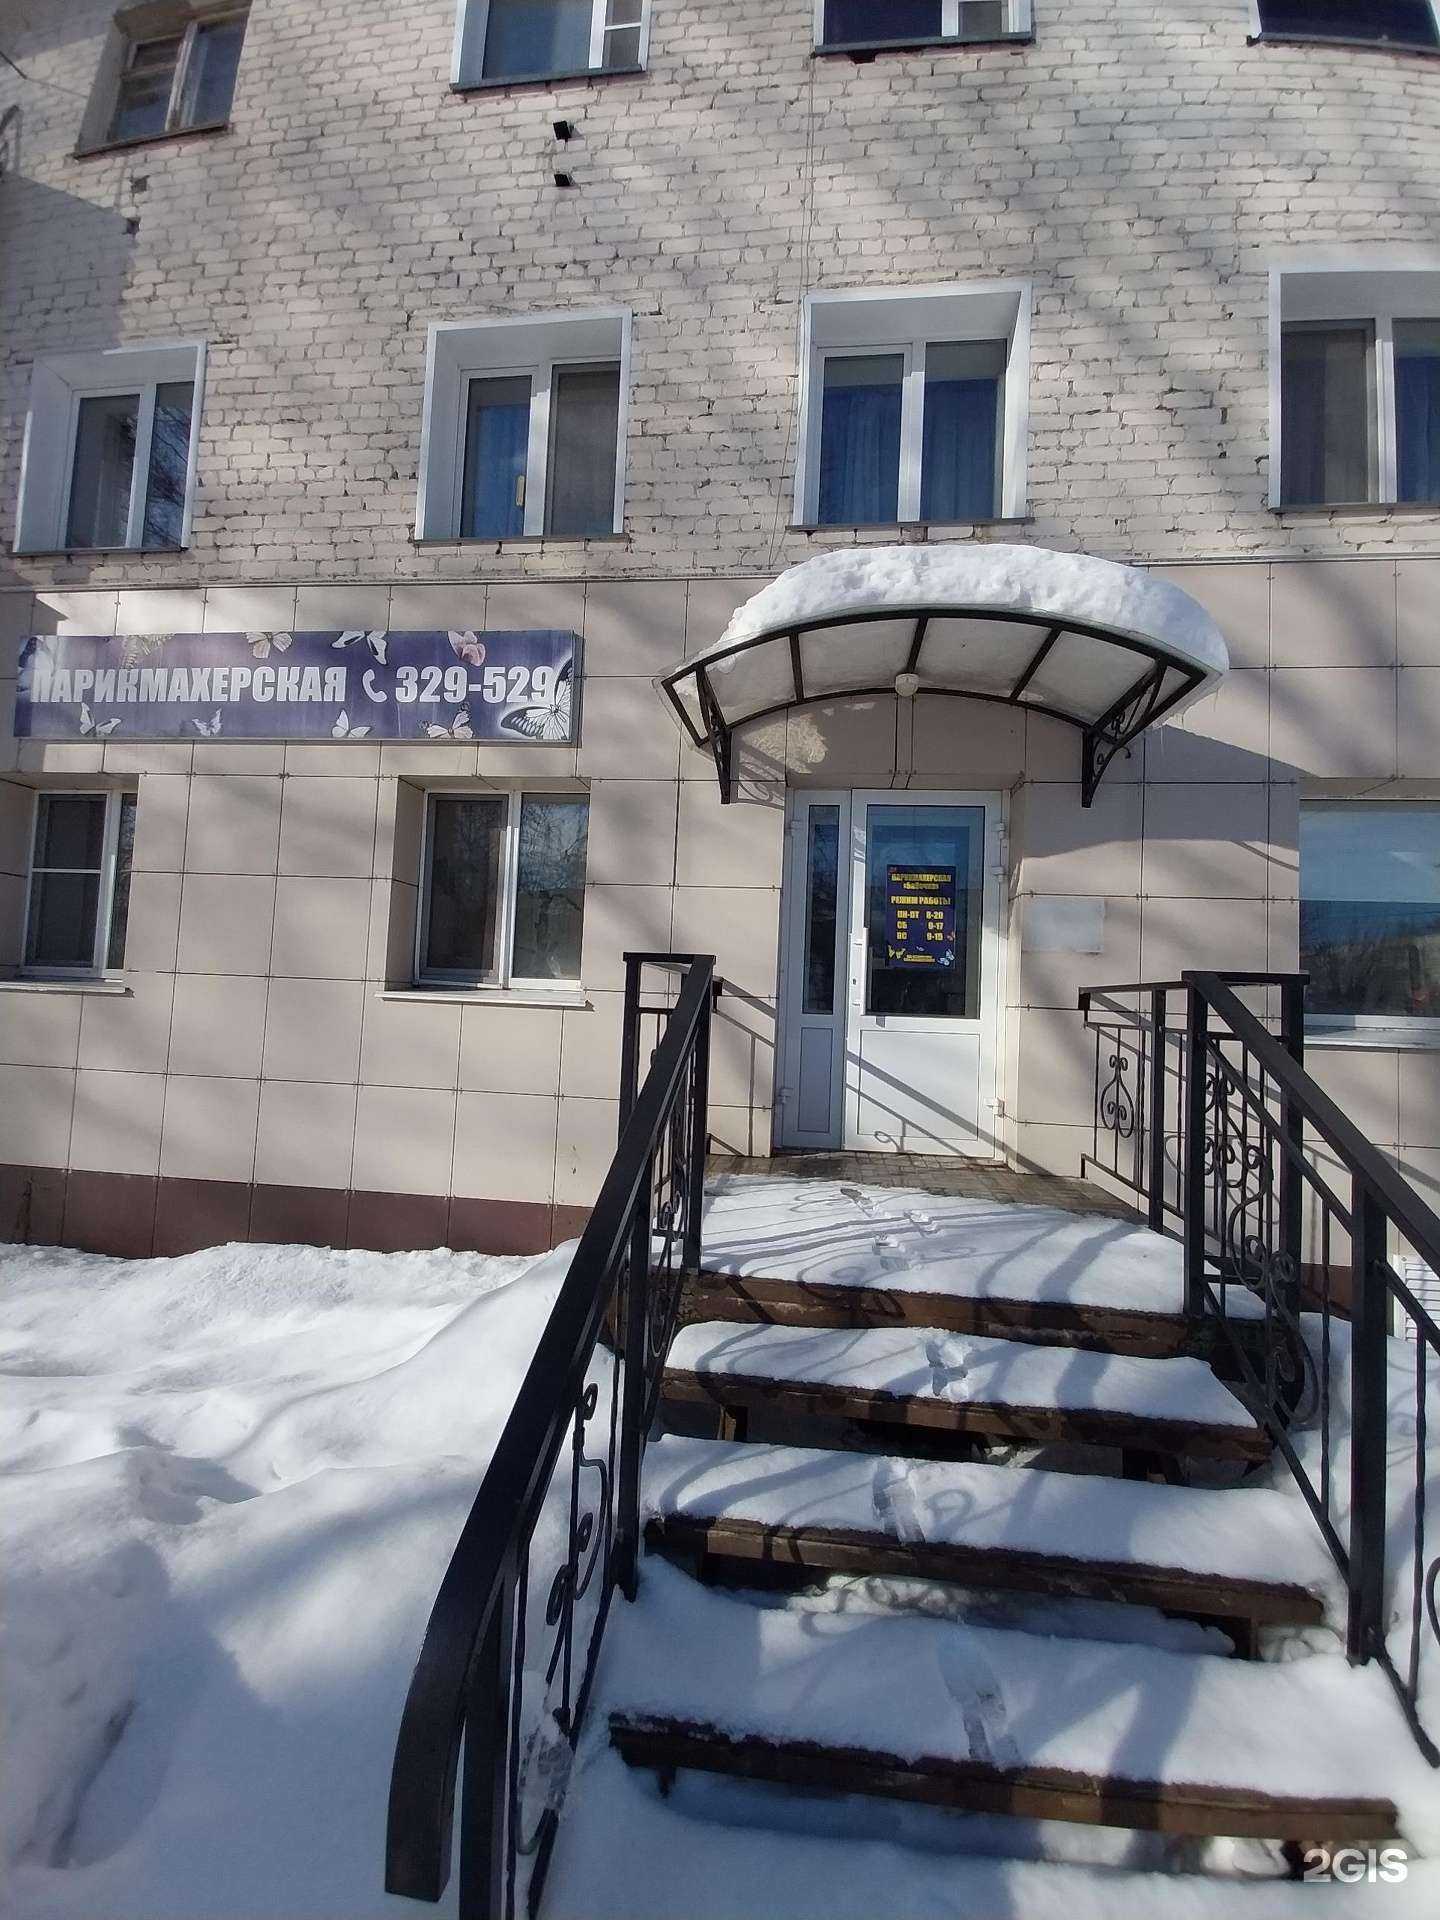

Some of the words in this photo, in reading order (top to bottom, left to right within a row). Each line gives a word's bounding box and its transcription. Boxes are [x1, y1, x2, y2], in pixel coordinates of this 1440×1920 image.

[30, 666, 347, 703] ПАРИКМАХЕРСКАЯ
[395, 665, 555, 703] 329-529
[891, 895, 918, 904] РЕЖИМ
[919, 896, 951, 905] РАБОТЫ
